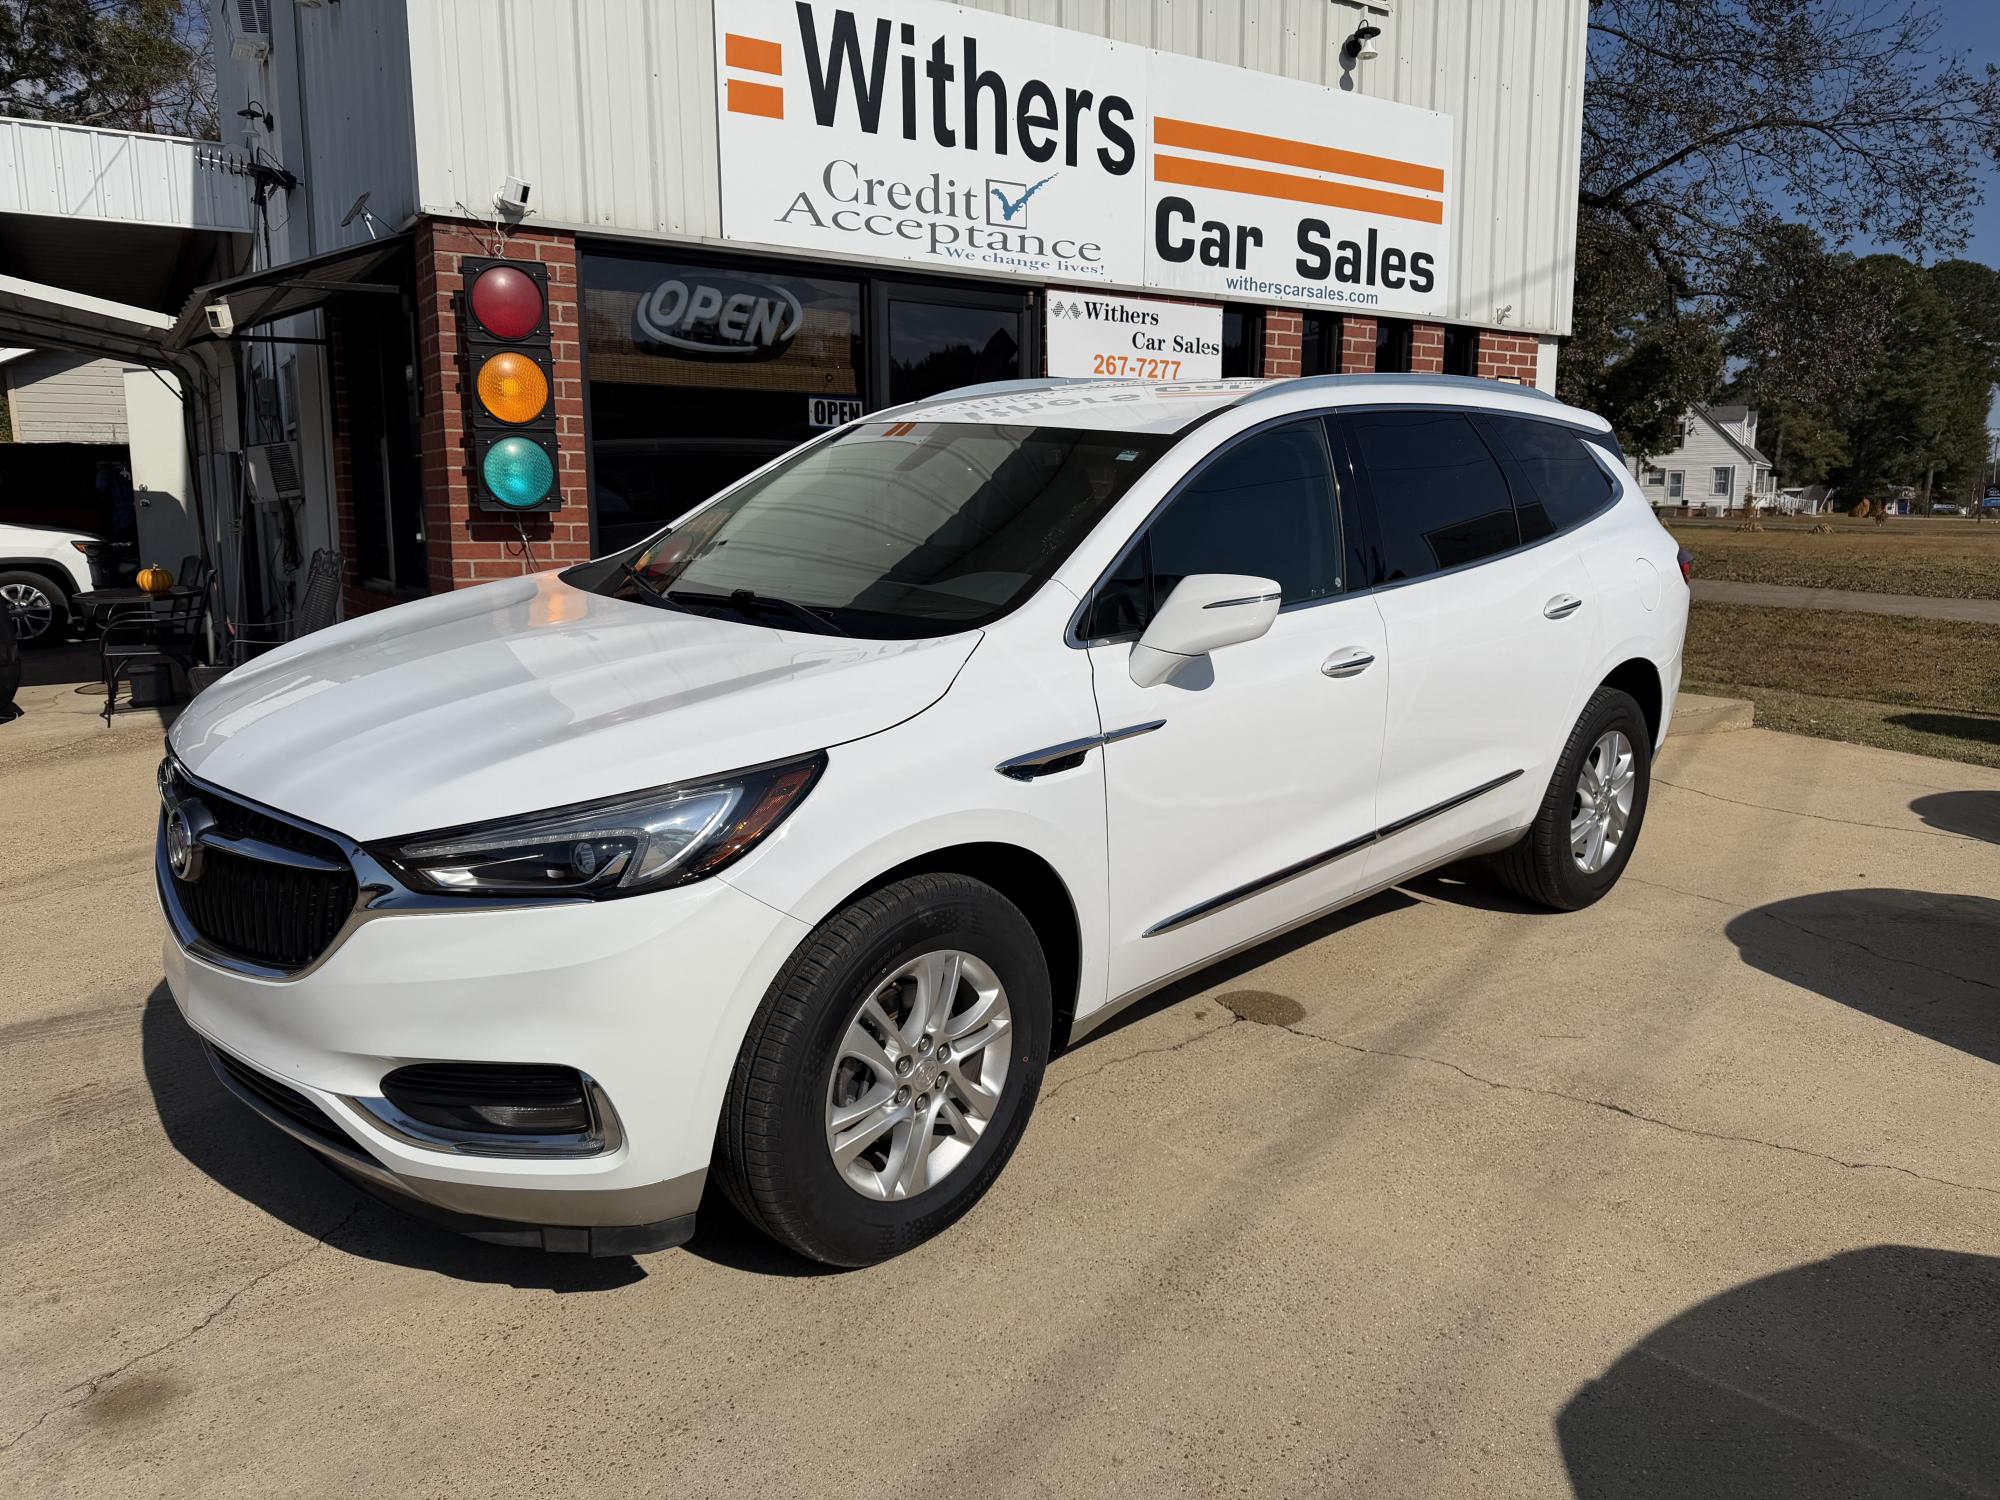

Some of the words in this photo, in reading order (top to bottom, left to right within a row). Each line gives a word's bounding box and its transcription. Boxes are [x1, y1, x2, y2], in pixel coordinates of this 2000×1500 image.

[795, 1, 1136, 176] Withers
[822, 159, 980, 221] Credit
[774, 191, 1102, 262] Acceptance
[1155, 196, 1264, 270] Car
[1295, 217, 1435, 293] Sales
[945, 246, 976, 260] We
[982, 252, 1051, 271] change
[1057, 260, 1105, 275] lives!
[1226, 275, 1378, 304] witherscarsales.com
[650, 280, 787, 346] OPEN
[1084, 301, 1159, 326] Withers
[1132, 331, 1166, 351] Car
[1172, 335, 1220, 356] Sales
[1093, 354, 1181, 380] 267-7277
[814, 400, 860, 425] OPEN
